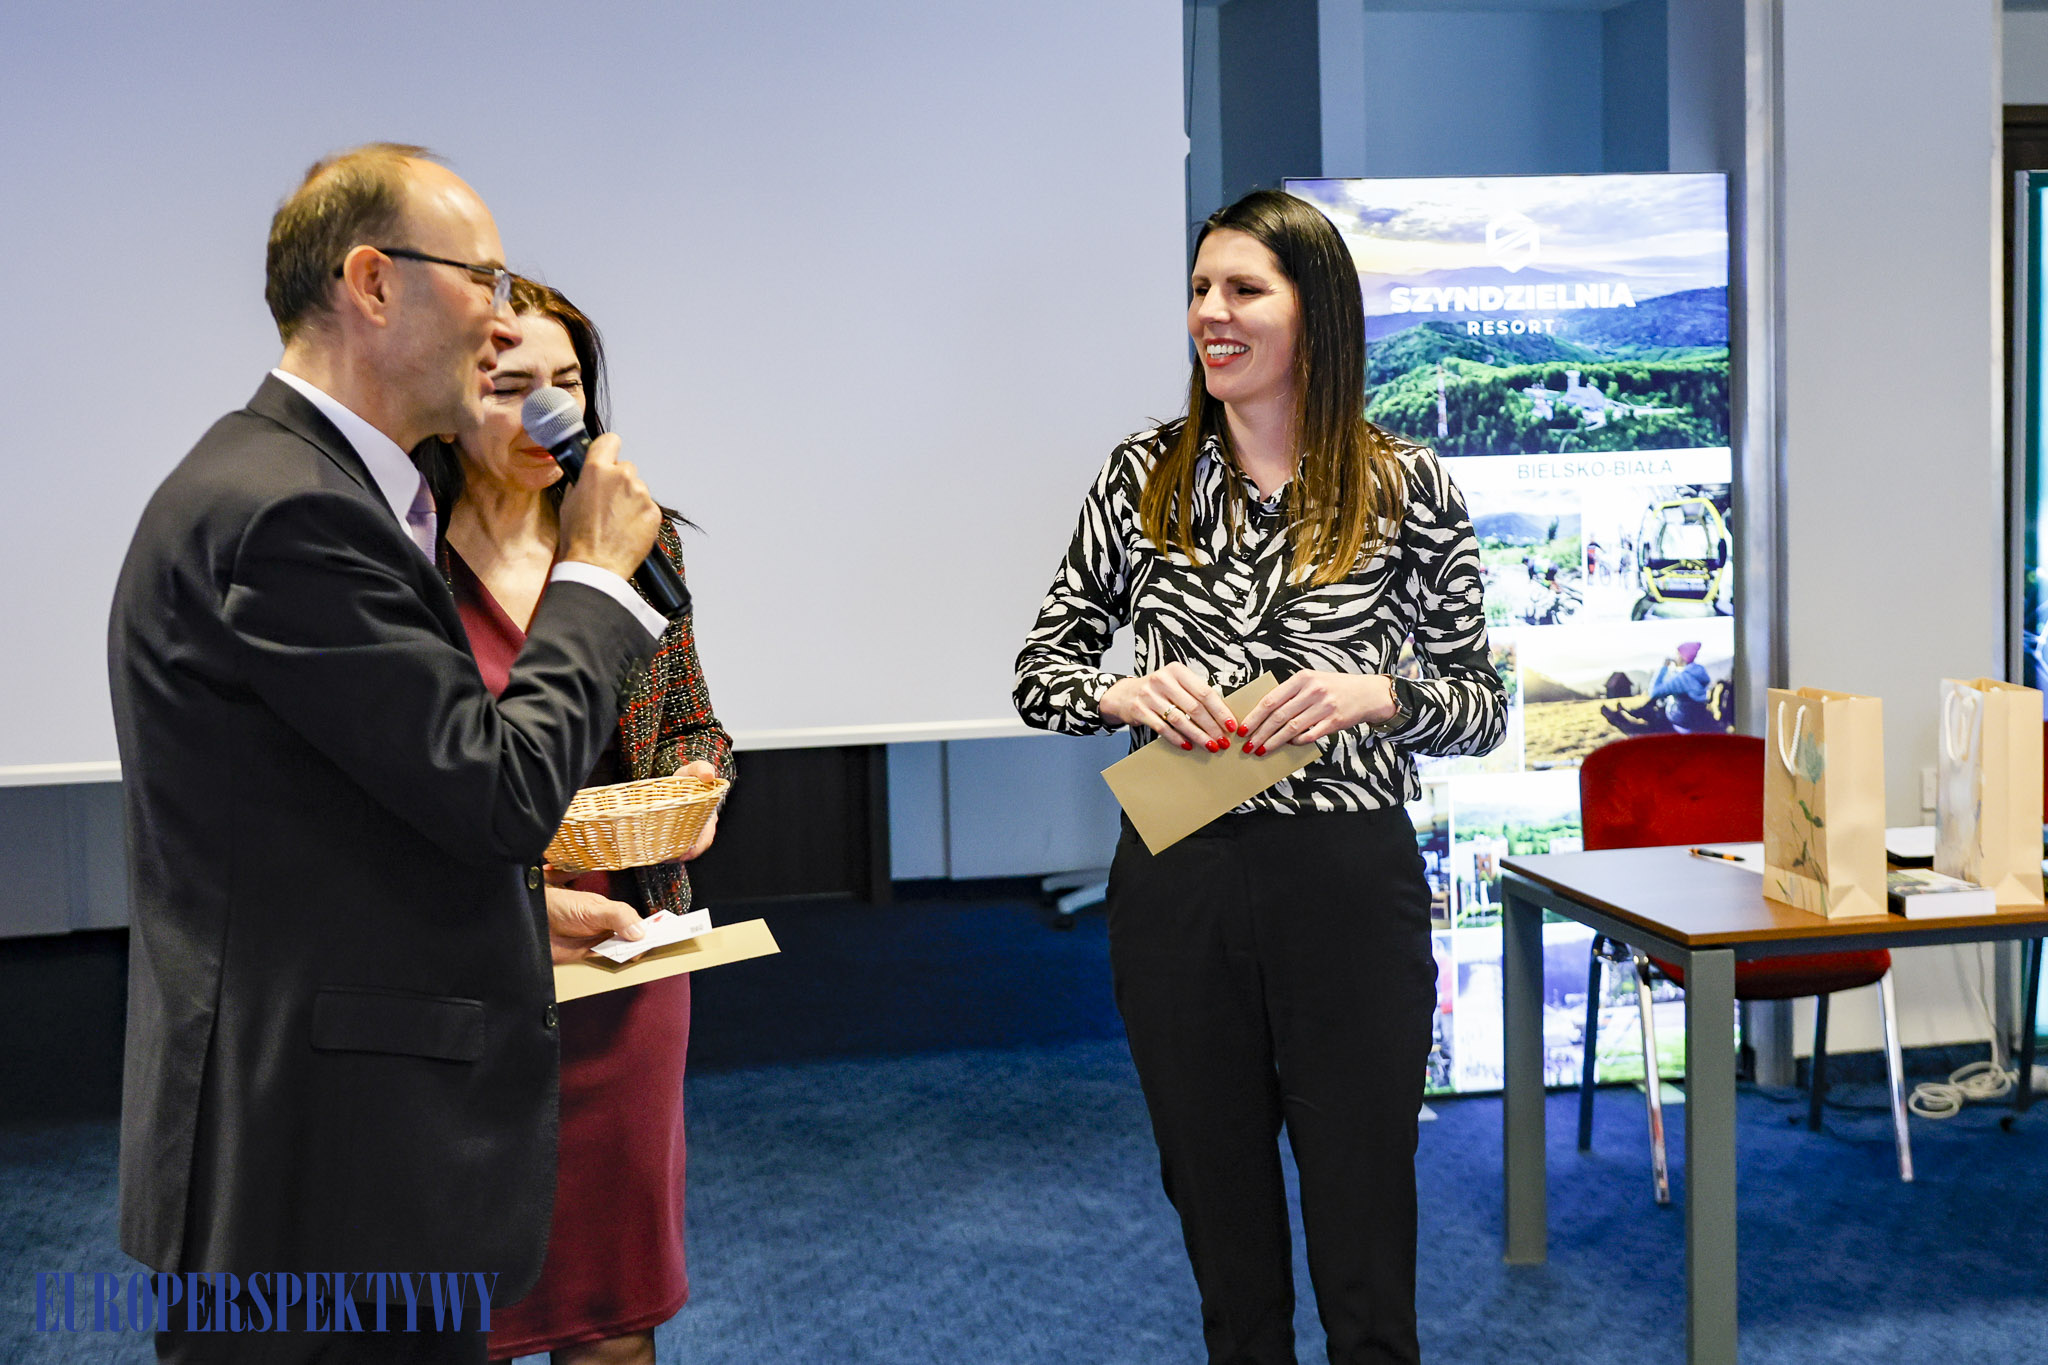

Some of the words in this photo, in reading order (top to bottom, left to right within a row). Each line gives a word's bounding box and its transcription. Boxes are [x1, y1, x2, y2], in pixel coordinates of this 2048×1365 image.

[1390, 282, 1636, 313] SZYNDZIELNIA
[1467, 318, 1556, 335] RESORT
[1517, 459, 1673, 480] BIELSKO-BIAŁA
